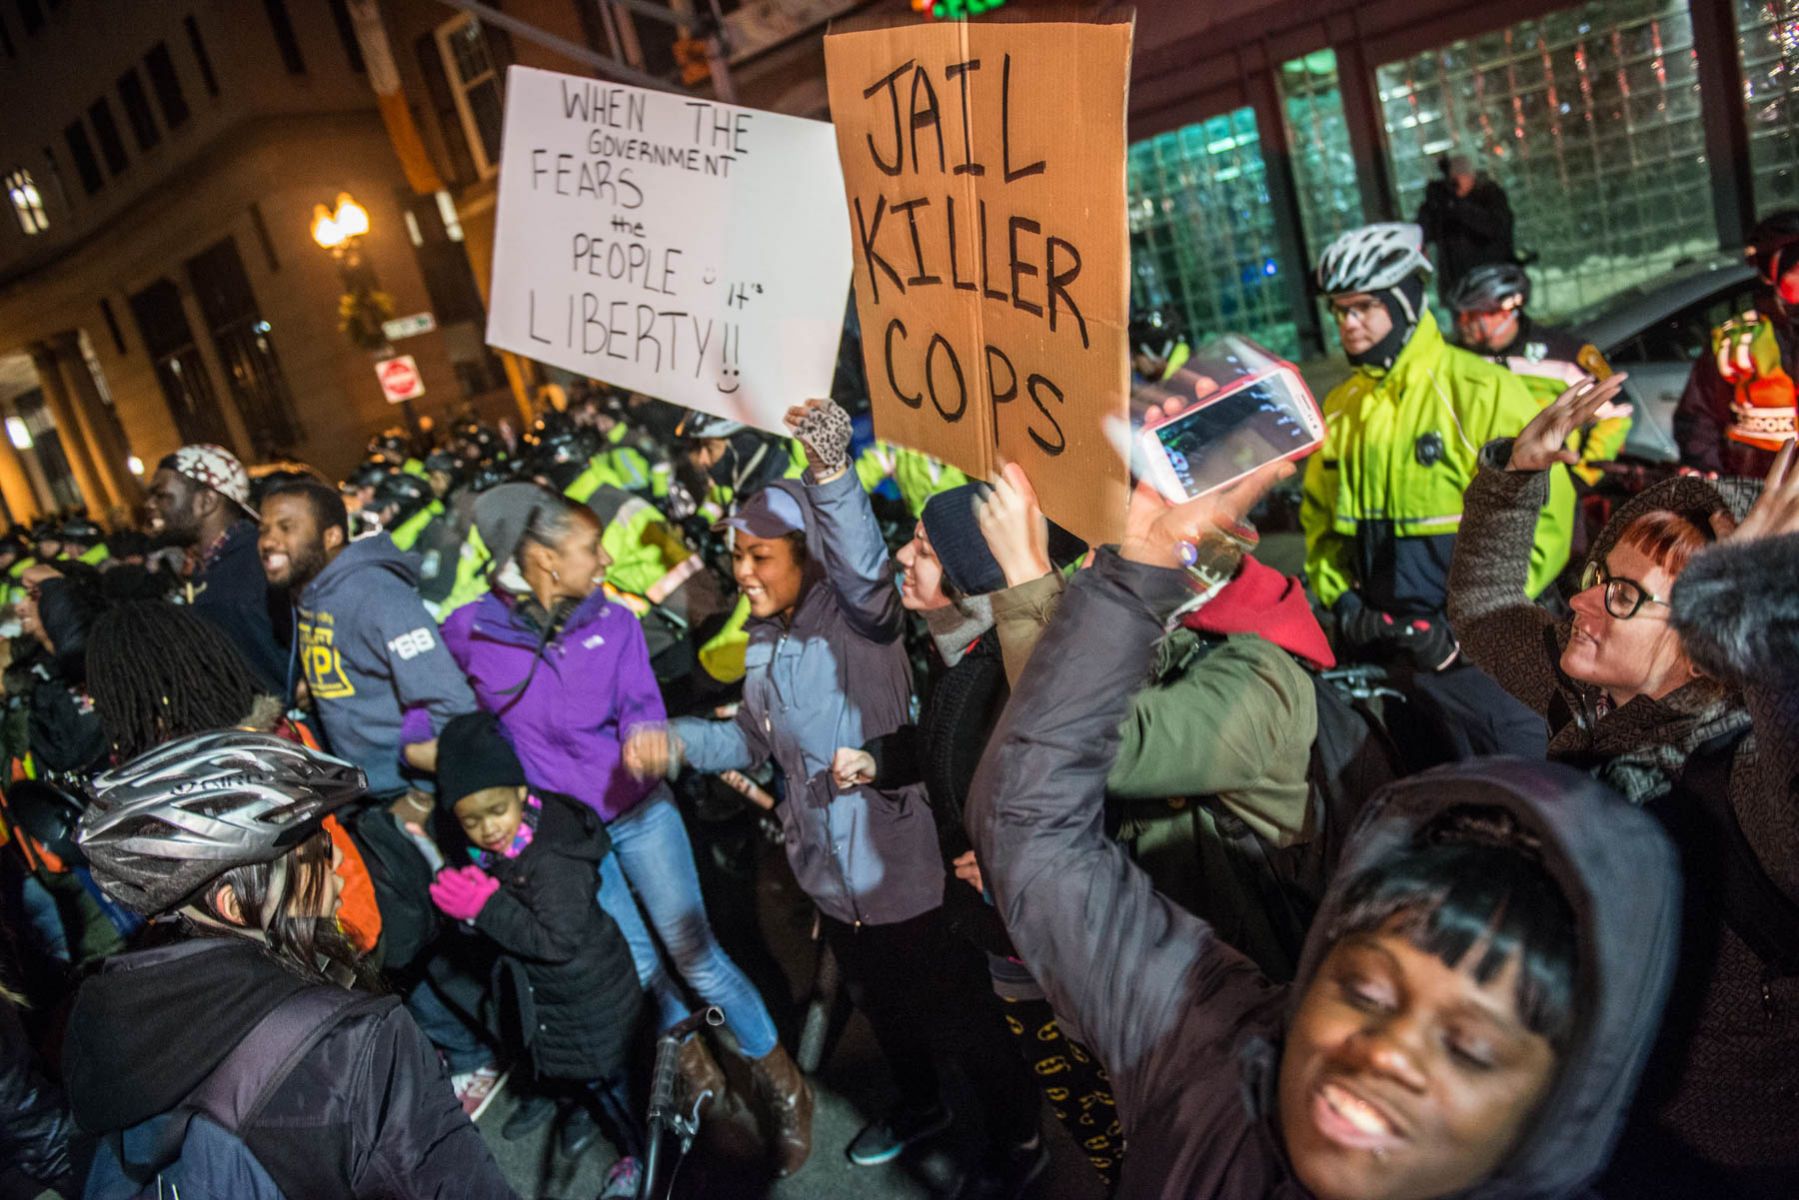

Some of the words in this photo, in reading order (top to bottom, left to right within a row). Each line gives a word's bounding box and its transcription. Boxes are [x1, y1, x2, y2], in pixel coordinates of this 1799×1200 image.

[562, 79, 646, 132] WHEN
[685, 102, 752, 154] THE
[864, 53, 1046, 183] JAIL
[532, 149, 644, 209] FEARS
[588, 129, 737, 177] GOVERNMENT
[610, 215, 646, 237] the
[573, 233, 682, 295] PEOPLE
[855, 195, 1089, 349] KILLER
[885, 318, 1066, 456] COPS
